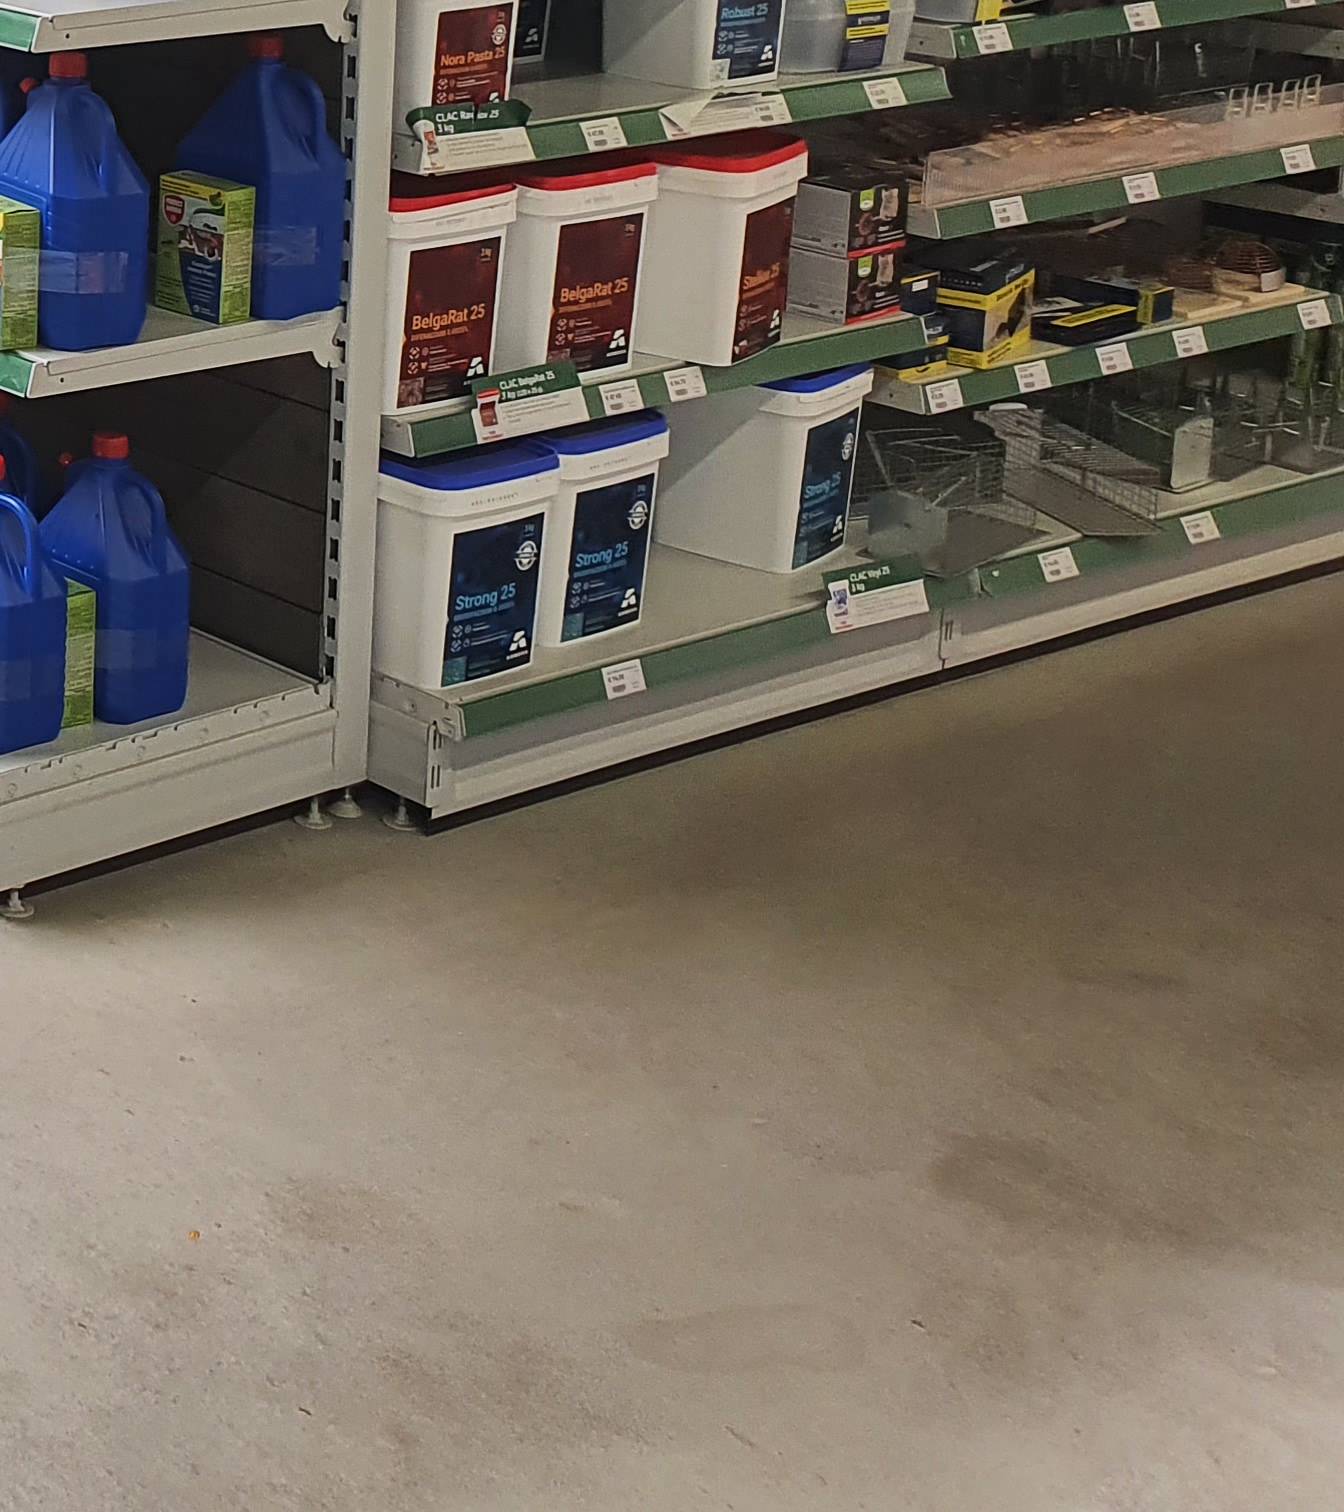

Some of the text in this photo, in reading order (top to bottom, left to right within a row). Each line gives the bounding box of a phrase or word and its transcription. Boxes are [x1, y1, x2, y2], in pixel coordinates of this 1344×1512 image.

[721, 2, 770, 20] Robust 25
[440, 46, 506, 67] Nora Pasta 25
[435, 111, 459, 123] CLAC
[560, 277, 629, 303] BelgaRat 25
[411, 308, 469, 332] BelgaRat
[470, 303, 486, 320] 25
[499, 378, 517, 390] CLAC
[575, 541, 629, 568] Strong 25
[455, 582, 516, 610] Strong 25
